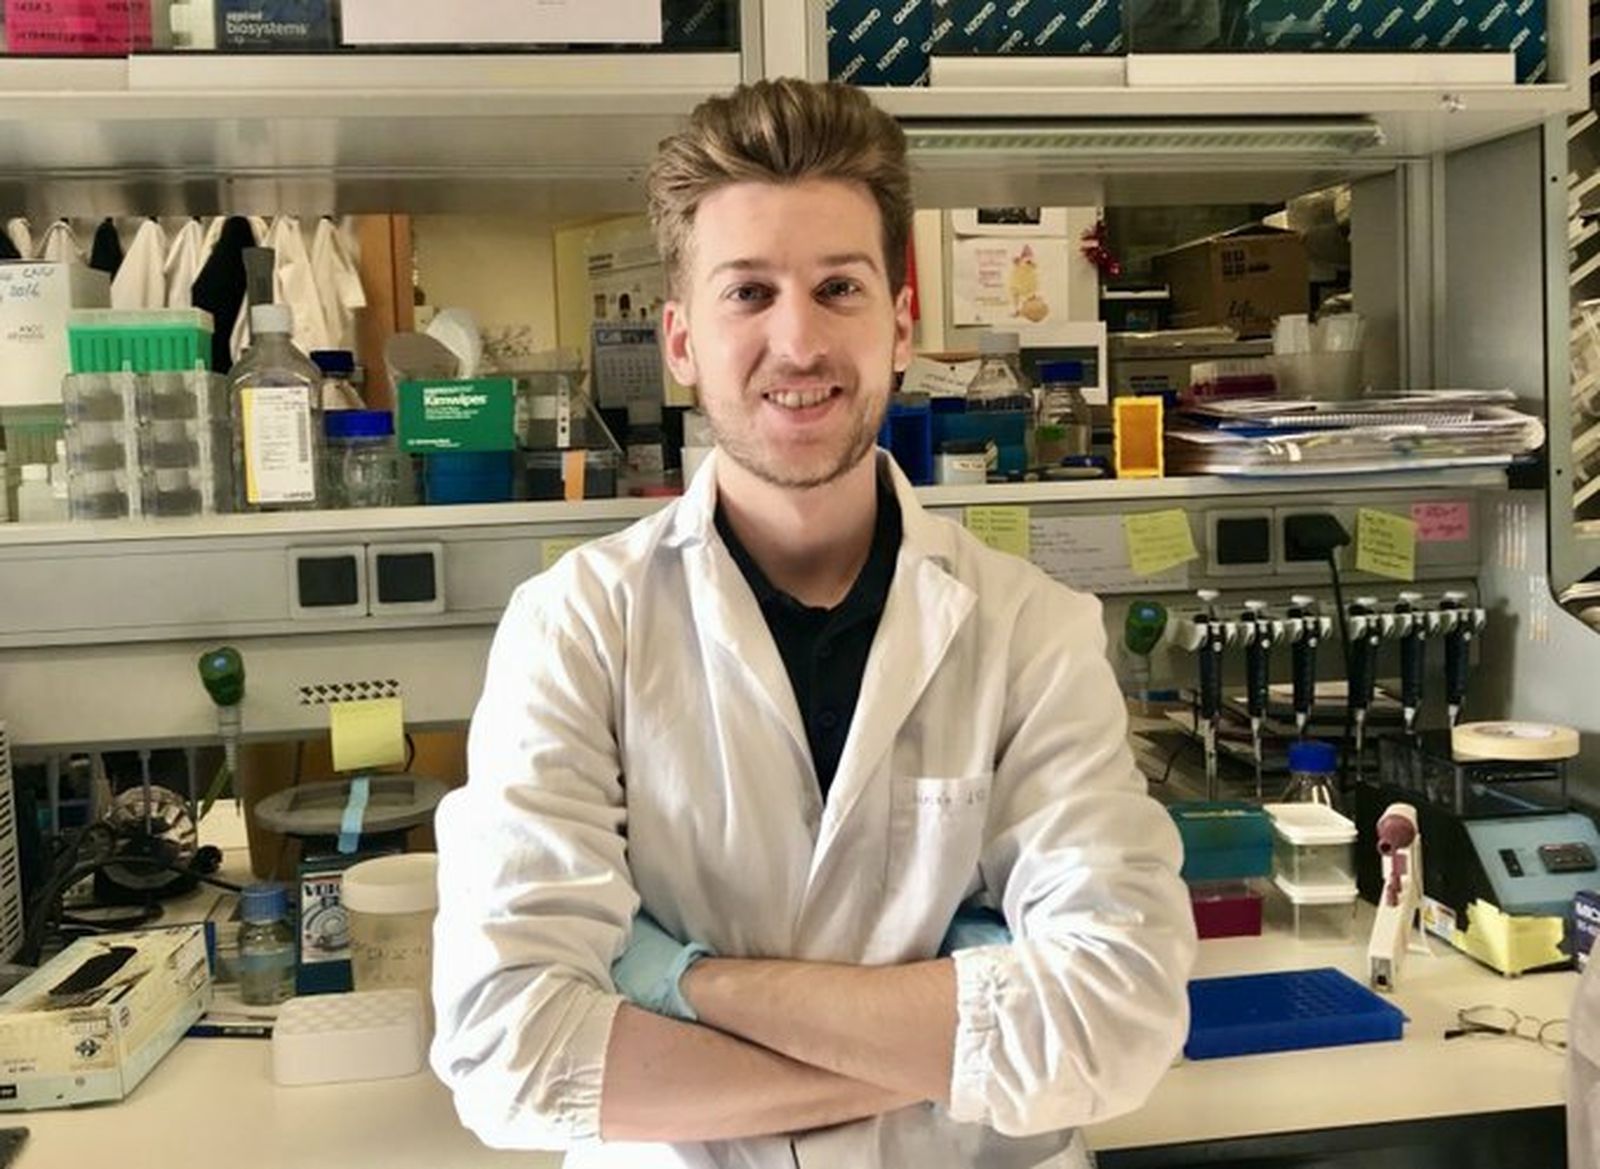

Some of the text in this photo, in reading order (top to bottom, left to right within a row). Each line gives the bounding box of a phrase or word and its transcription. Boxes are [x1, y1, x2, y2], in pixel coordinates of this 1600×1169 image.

[226, 20, 307, 38] biosystems
[848, 8, 881, 43] QIAGEN
[892, 0, 922, 25] QIAG
[963, 1, 997, 36] QIAGEN
[1034, 12, 1067, 46] QIAGEN
[920, 18, 954, 53] QIAGEN
[876, 36, 909, 71] QIAGEN
